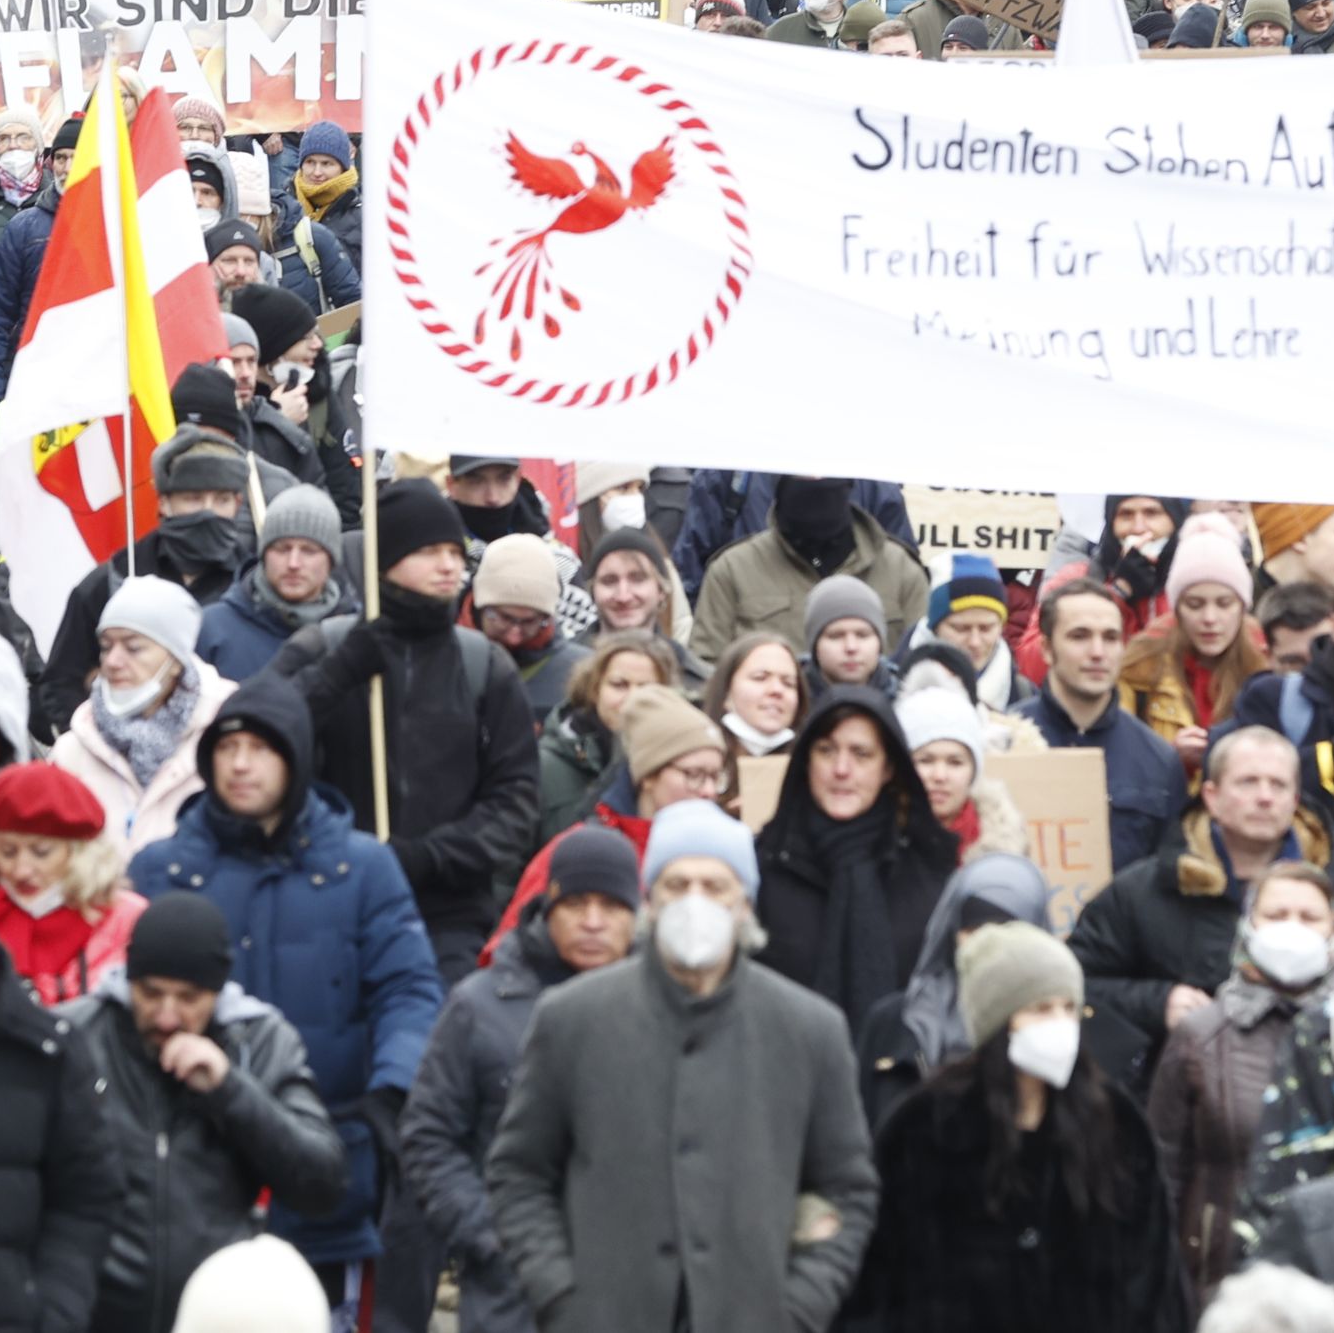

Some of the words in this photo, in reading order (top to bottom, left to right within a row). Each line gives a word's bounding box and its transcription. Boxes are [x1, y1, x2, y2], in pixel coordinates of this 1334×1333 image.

[843, 213, 1001, 279] Freiheit
[1028, 220, 1103, 279] für
[1131, 296, 1198, 359] und
[1210, 295, 1302, 359] Lehre
